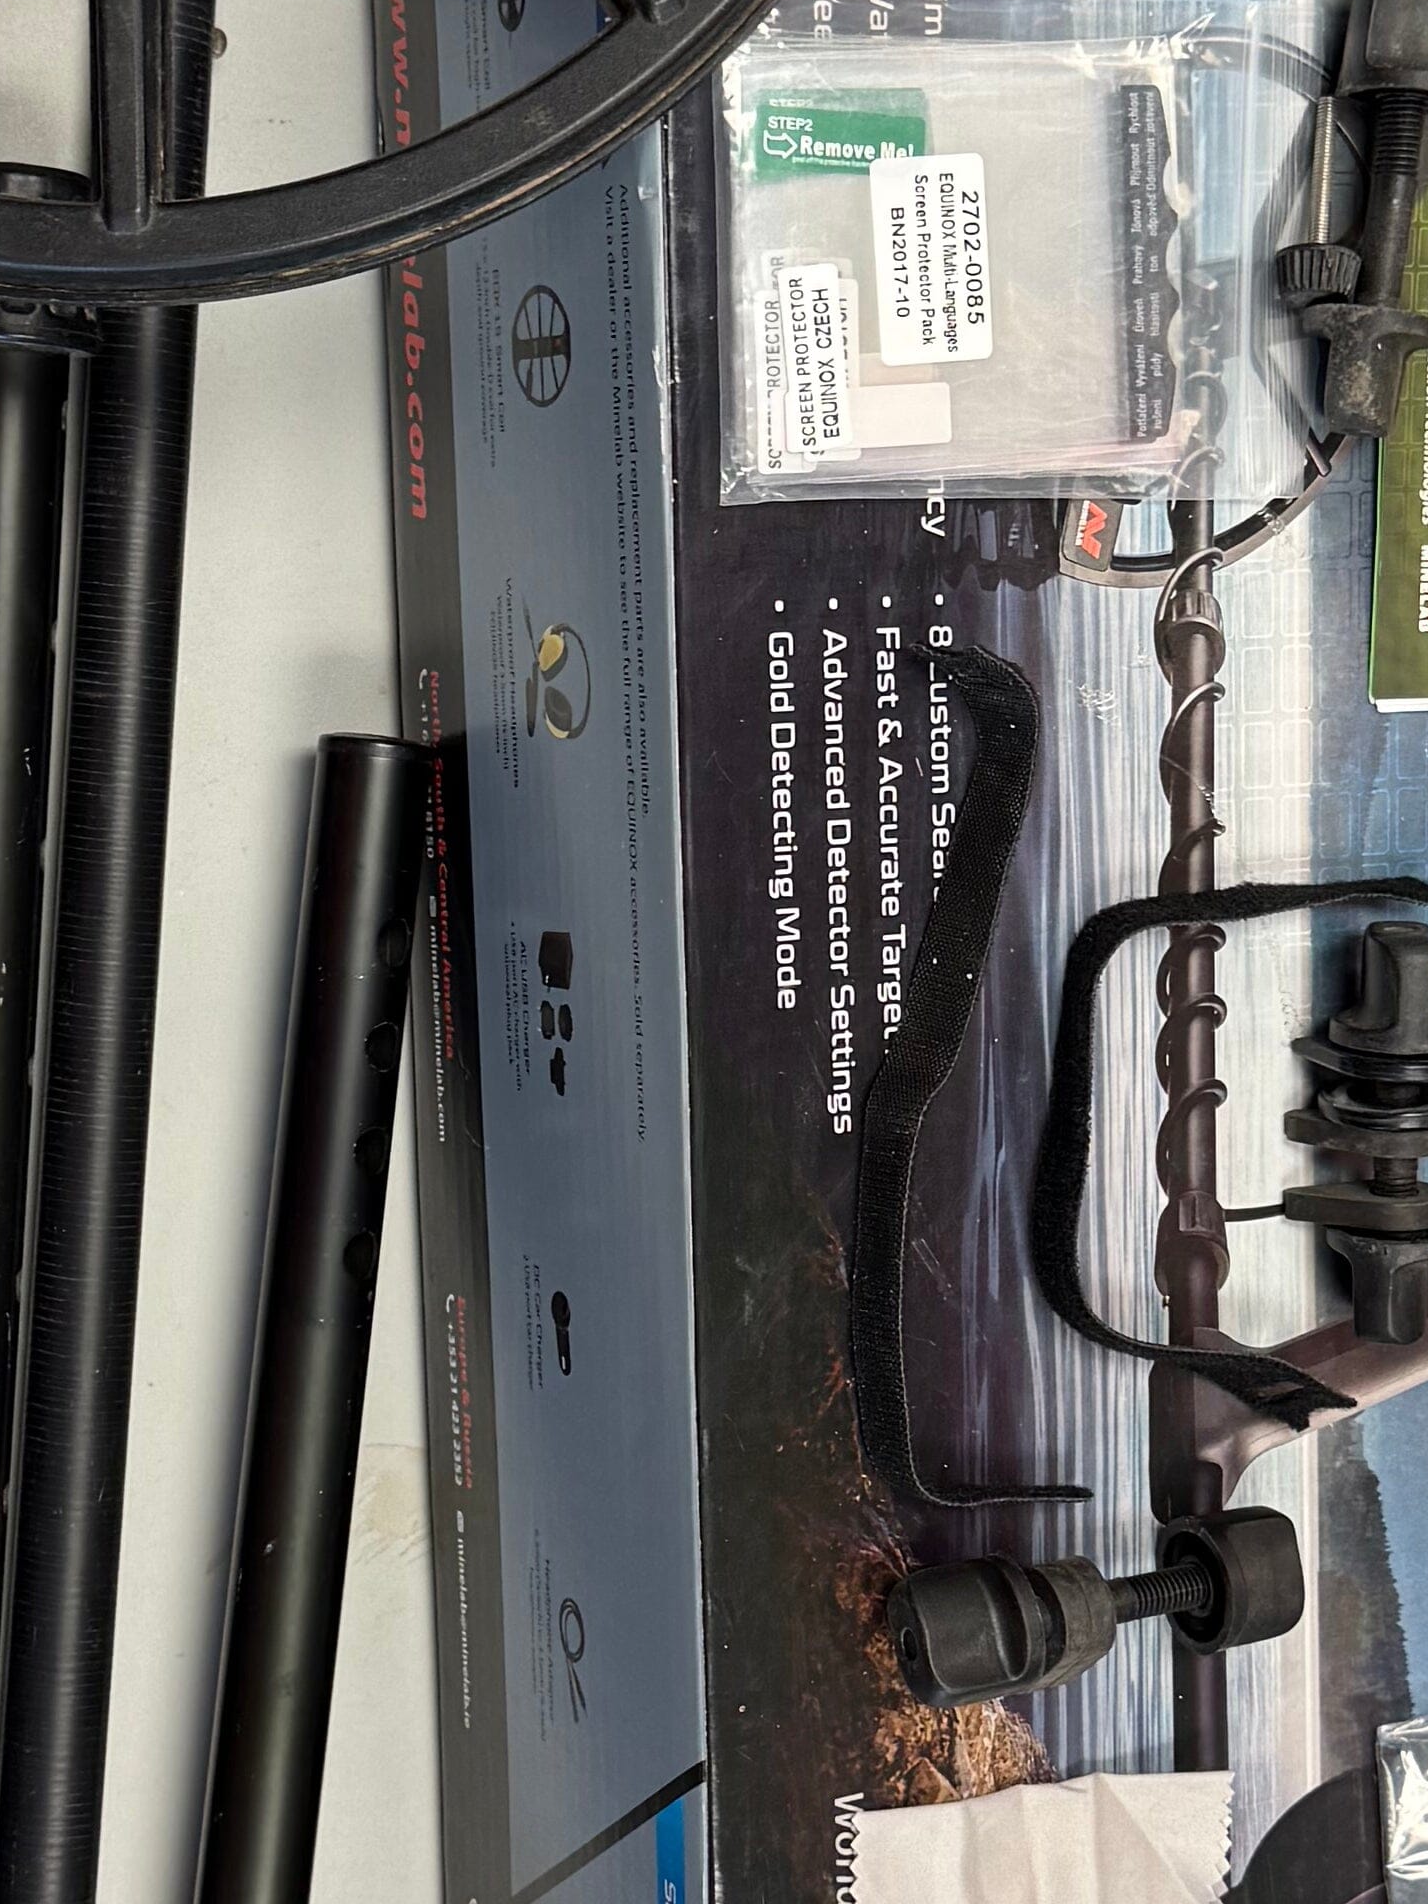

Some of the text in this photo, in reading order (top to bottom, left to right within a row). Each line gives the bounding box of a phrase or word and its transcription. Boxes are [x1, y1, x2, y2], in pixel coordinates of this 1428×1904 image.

[768, 115, 813, 132] STEP2
[799, 135, 876, 160] Remove
[604, 184, 616, 229] Visit
[605, 235, 615, 246] a
[890, 207, 910, 318] BN2017-10
[914, 174, 936, 346] Screen Protector Pack
[939, 172, 958, 353] EQUINOX Multi-Languages
[961, 190, 985, 325] 2702-0085
[605, 252, 618, 316] dealer
[607, 321, 618, 344] or
[788, 278, 816, 447] SCREEN PROTECTOR
[813, 287, 840, 440] EQUINOX CZECH
[609, 349, 620, 381] the
[611, 385, 625, 468] Minelab
[614, 473, 627, 551] website
[618, 184, 652, 819] Additional accessories and replacement parts are also available.
[617, 556, 627, 576] to
[619, 581, 629, 615] see
[620, 620, 631, 652] the
[927, 626, 953, 647] 8
[622, 656, 633, 687] full
[875, 627, 903, 710] Fast
[623, 693, 636, 746] range
[875, 718, 902, 747] &
[927, 662, 954, 795] ustom
[625, 752, 637, 775] of
[626, 780, 638, 872] EQUINOX
[767, 631, 800, 1010] Gold Detecting Mode
[877, 756, 905, 917] Accurate
[822, 628, 856, 1136] Advanced Detector Settings
[633, 995, 645, 1038] Sold
